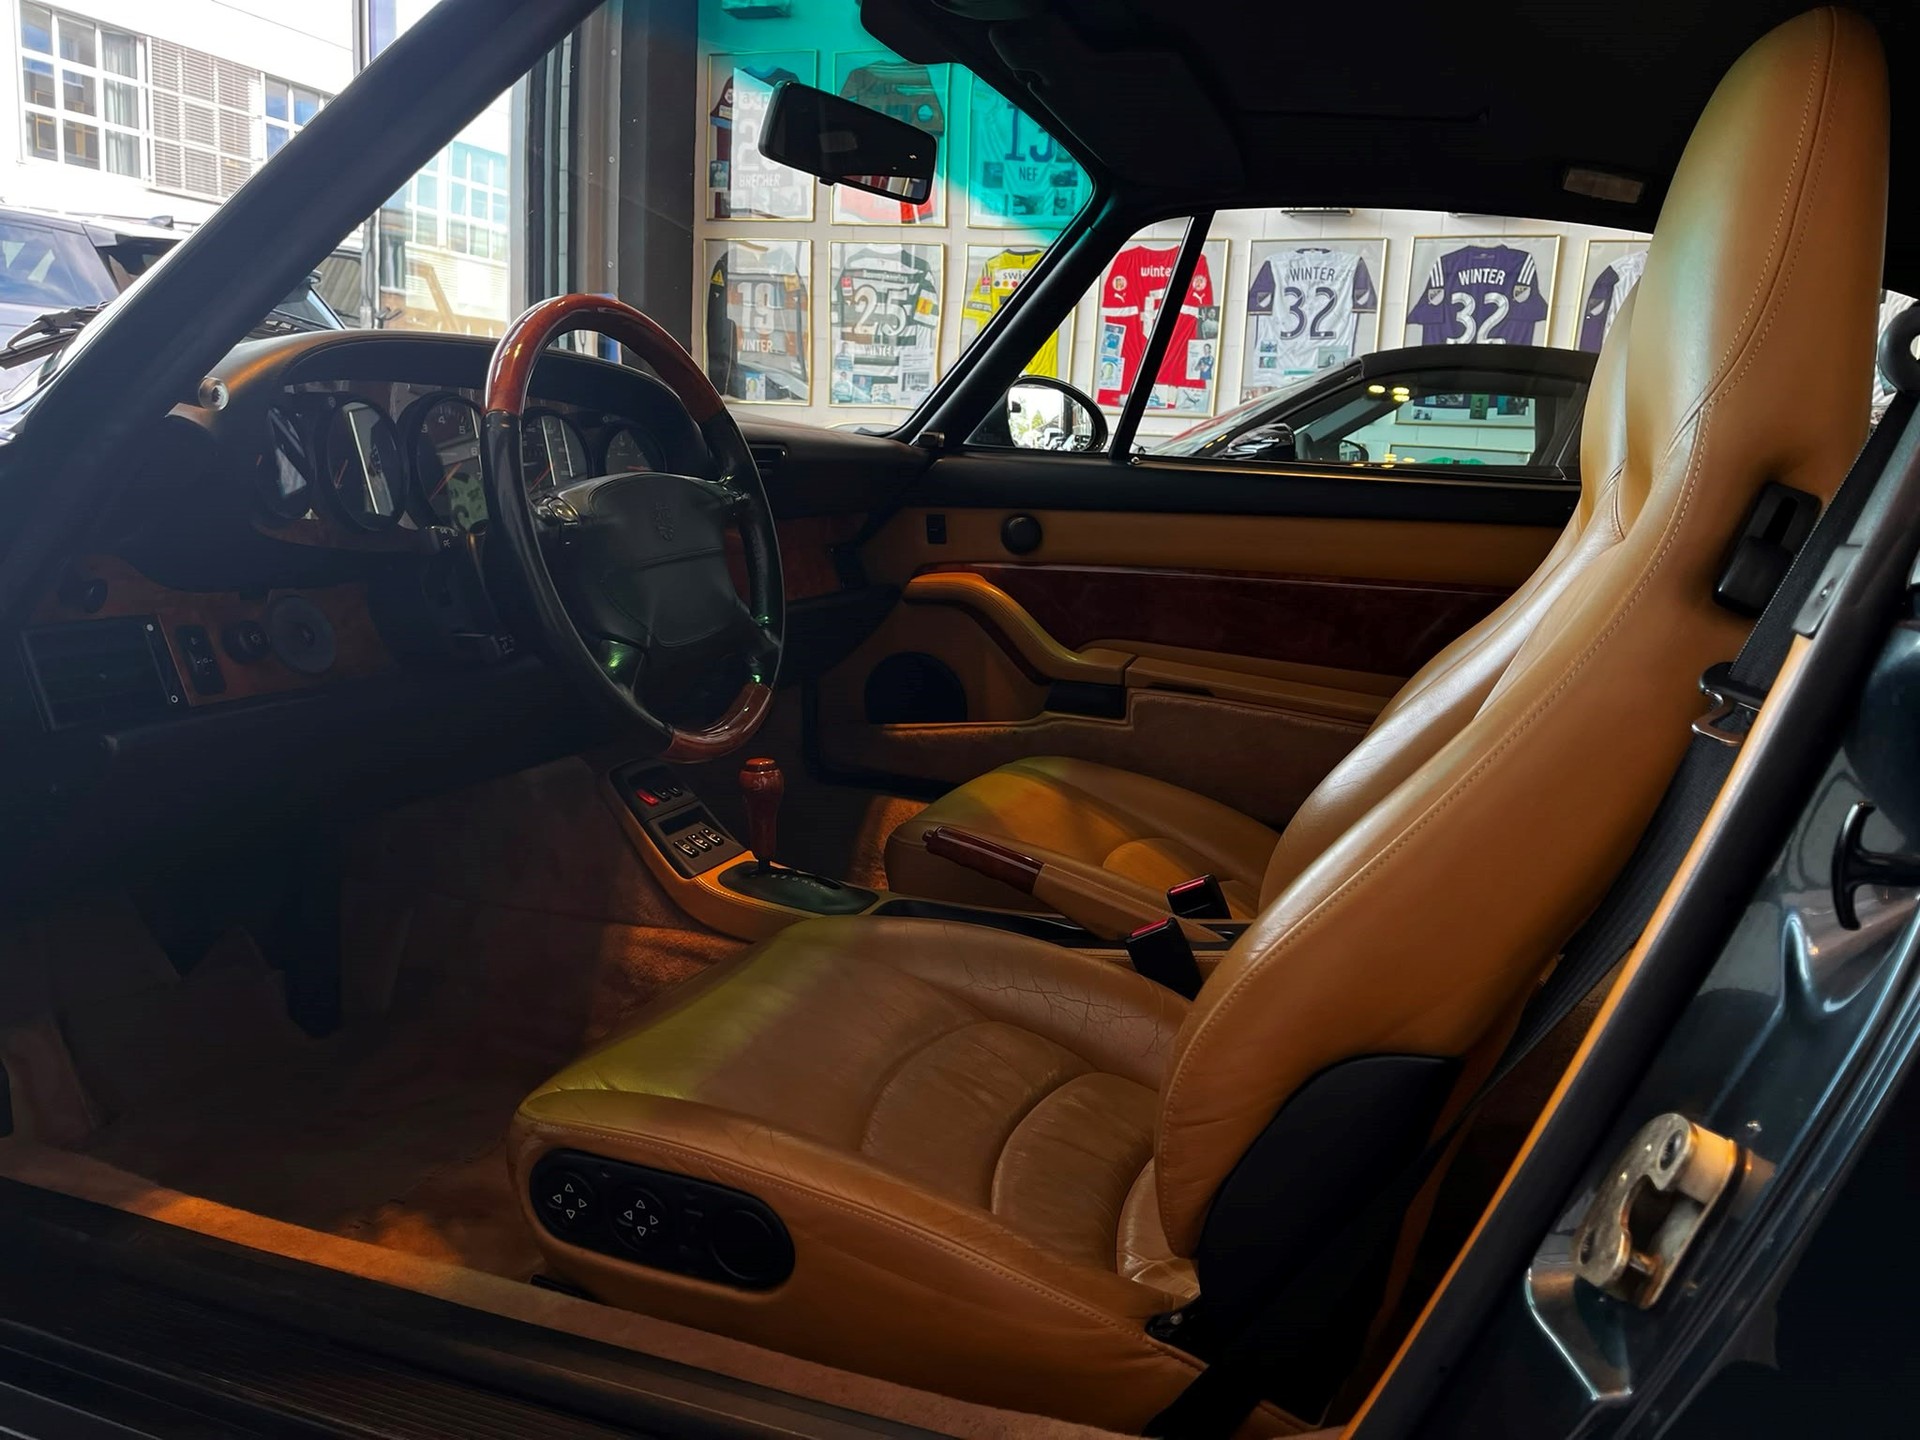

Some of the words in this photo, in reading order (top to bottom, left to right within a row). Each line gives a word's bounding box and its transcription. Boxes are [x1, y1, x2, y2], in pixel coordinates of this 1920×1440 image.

[1019, 166, 1039, 181] NEF
[1140, 265, 1172, 277] winte
[1290, 266, 1336, 282] WINTER
[1458, 268, 1506, 286] WINTER
[737, 281, 775, 335] 19
[853, 284, 908, 337] 25
[1280, 286, 1338, 340] 32
[1446, 292, 1510, 345] 32
